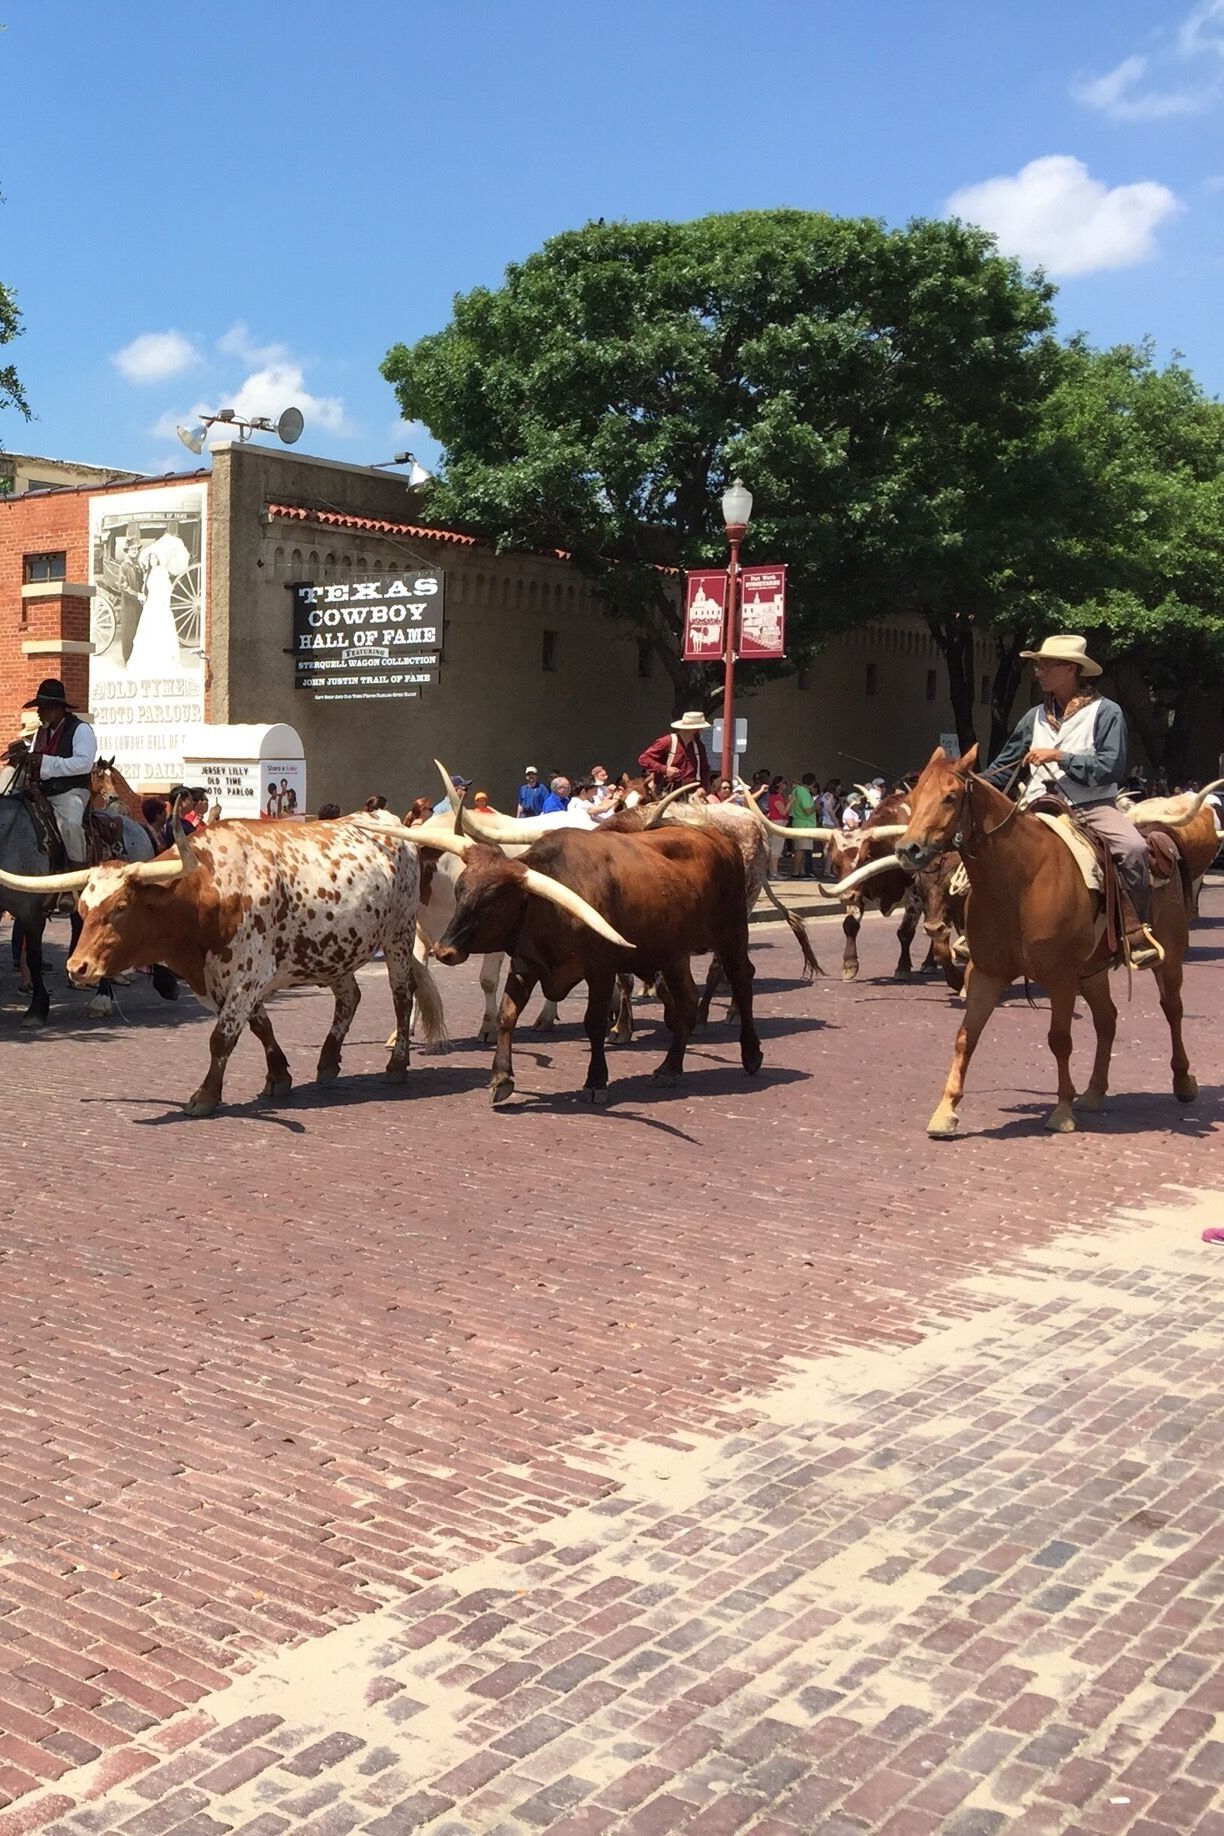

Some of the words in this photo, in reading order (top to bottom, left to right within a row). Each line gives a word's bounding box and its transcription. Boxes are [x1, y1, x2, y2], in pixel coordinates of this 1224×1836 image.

[299, 577, 438, 604] TEXAS
[308, 603, 427, 627] COWBOY
[299, 633, 349, 649] HALL
[353, 630, 378, 647] OF
[382, 627, 436, 645] FAME
[346, 649, 385, 658] FEATURING
[298, 658, 347, 670] STERQUELL
[348, 657, 380, 667] WAGON
[381, 656, 436, 666] COLLECTION
[303, 677, 325, 686] JOHN
[327, 675, 359, 685] JUSTIN
[360, 675, 389, 684] TRAIL
[390, 674, 403, 683] OF
[404, 673, 431, 683] FAME
[107, 680, 137, 699] OLD
[137, 703, 201, 723] PARLOUR
[201, 766, 226, 775] JERSEY
[228, 767, 249, 776] LILLY
[207, 776, 220, 785] OLD
[225, 777, 242, 786] TIME
[227, 787, 254, 797] PARLOR
